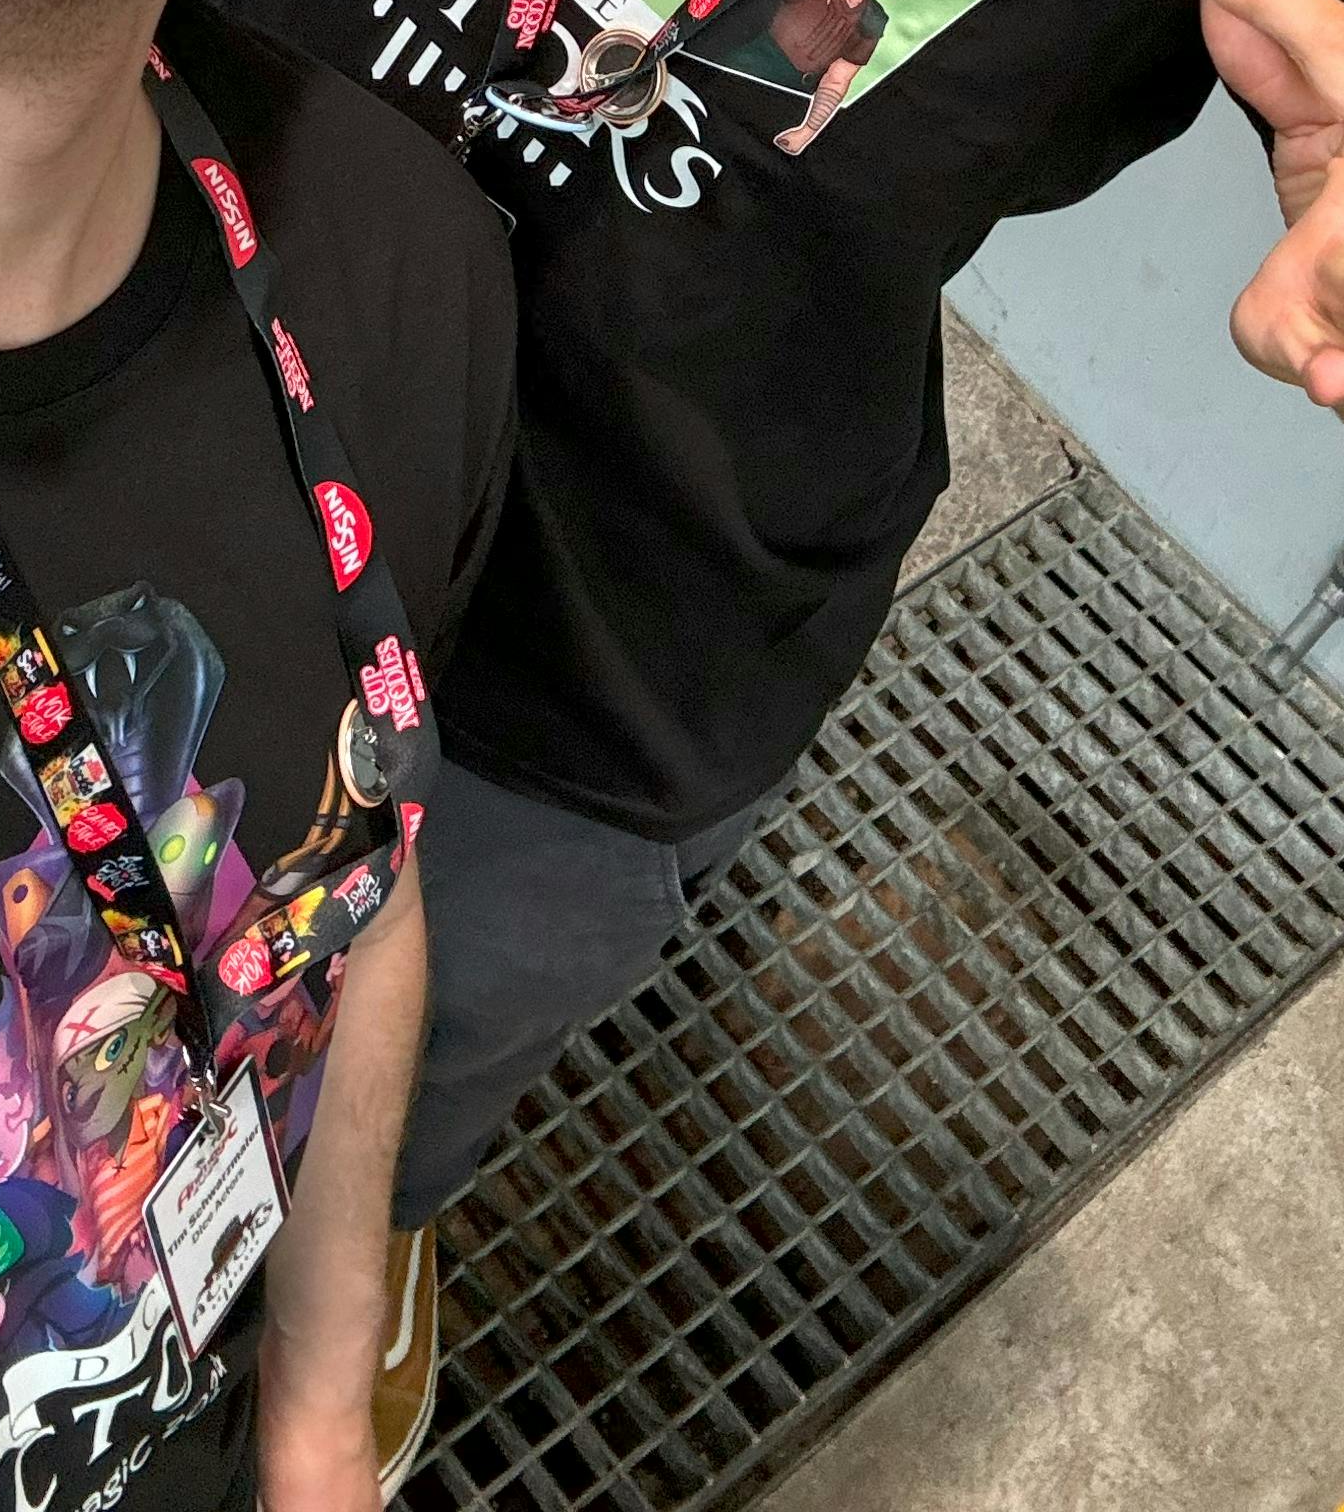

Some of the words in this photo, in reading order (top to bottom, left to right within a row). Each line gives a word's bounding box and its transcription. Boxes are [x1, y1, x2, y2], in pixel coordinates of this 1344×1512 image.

[204, 164, 256, 252] NISSIN
[323, 486, 364, 576] NISSIN
[359, 664, 391, 717] CUP
[374, 635, 420, 732] NOODLES
